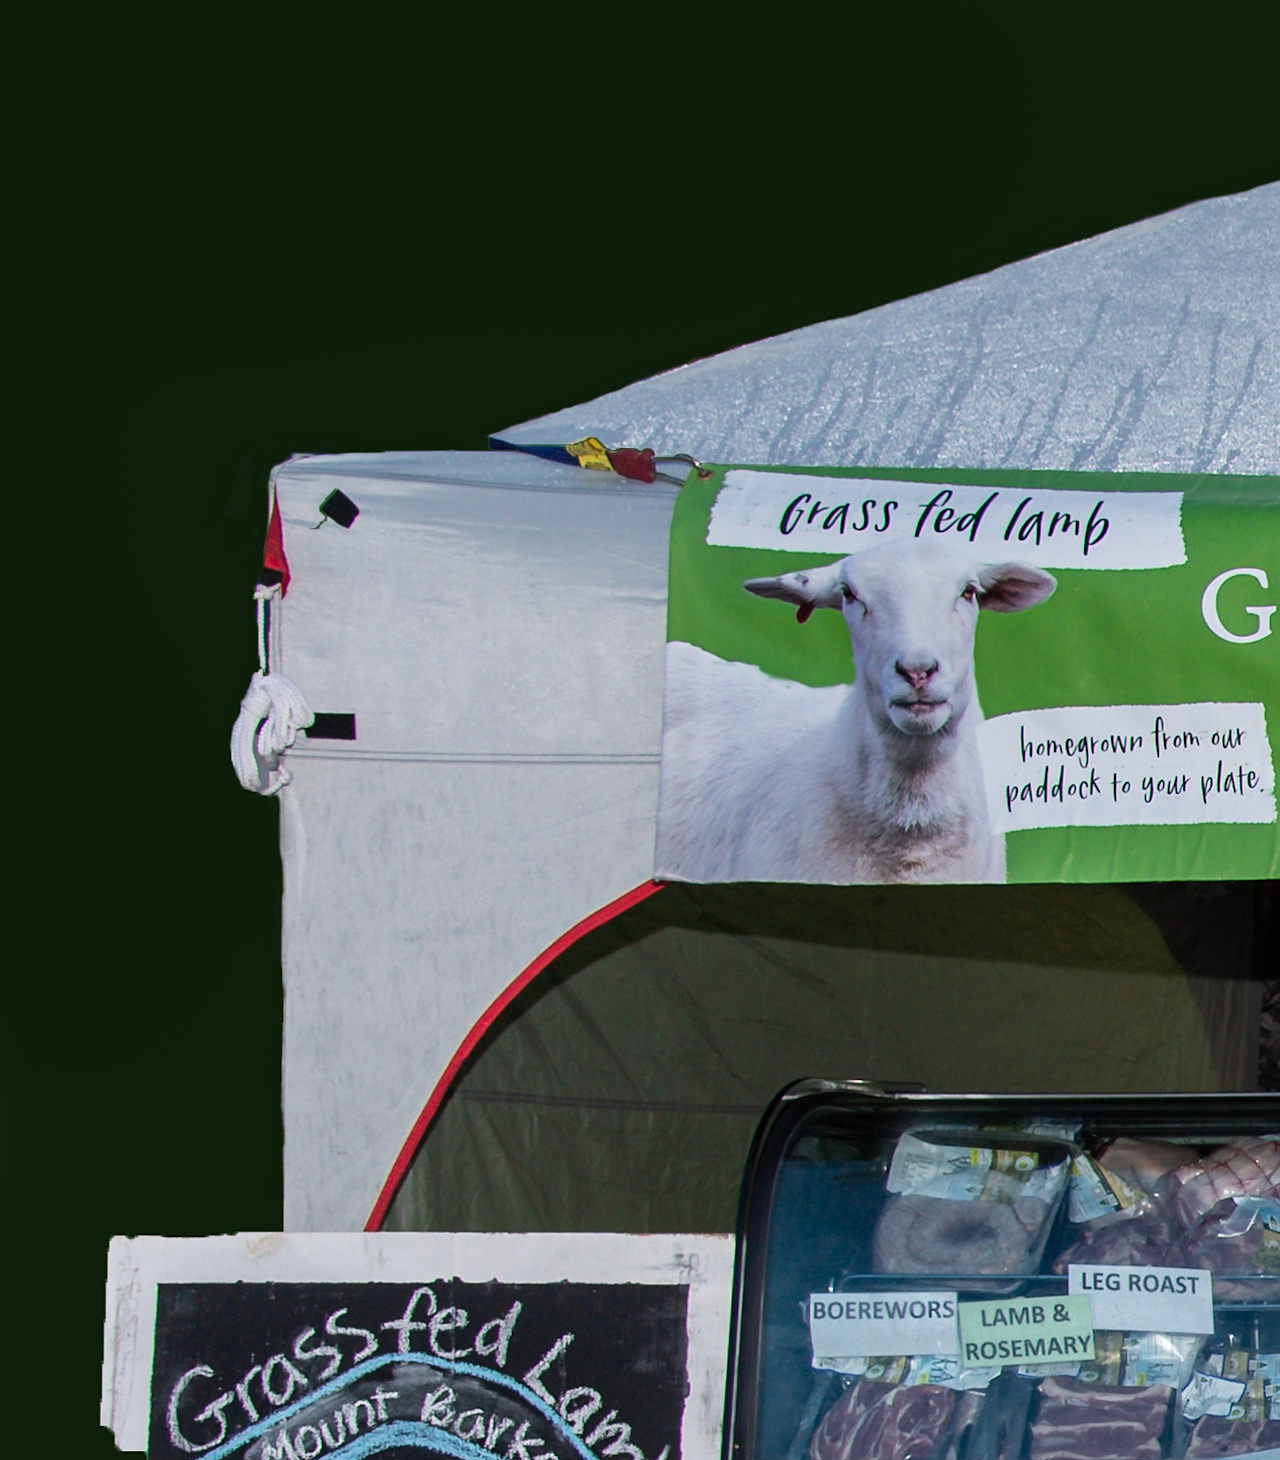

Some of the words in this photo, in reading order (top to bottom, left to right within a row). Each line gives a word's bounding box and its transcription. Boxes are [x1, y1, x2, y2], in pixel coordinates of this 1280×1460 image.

[778, 492, 898, 535] Grass
[914, 489, 999, 542] fed
[1003, 498, 1110, 556] lamb
[1019, 725, 1143, 771] homegrown
[1152, 715, 1202, 758] from
[1211, 727, 1248, 748] our
[1006, 771, 1102, 812] paddock
[1111, 771, 1133, 801] to
[1142, 773, 1191, 803] your
[1200, 760, 1264, 801] plate.
[1082, 1272, 1120, 1292] LEG
[1128, 1274, 1200, 1295] ROAST
[813, 1300, 954, 1320] BOEREWORS
[981, 1306, 1046, 1327] LAMB
[1053, 1303, 1071, 1322] &
[966, 1335, 1091, 1361] ROSEMARY
